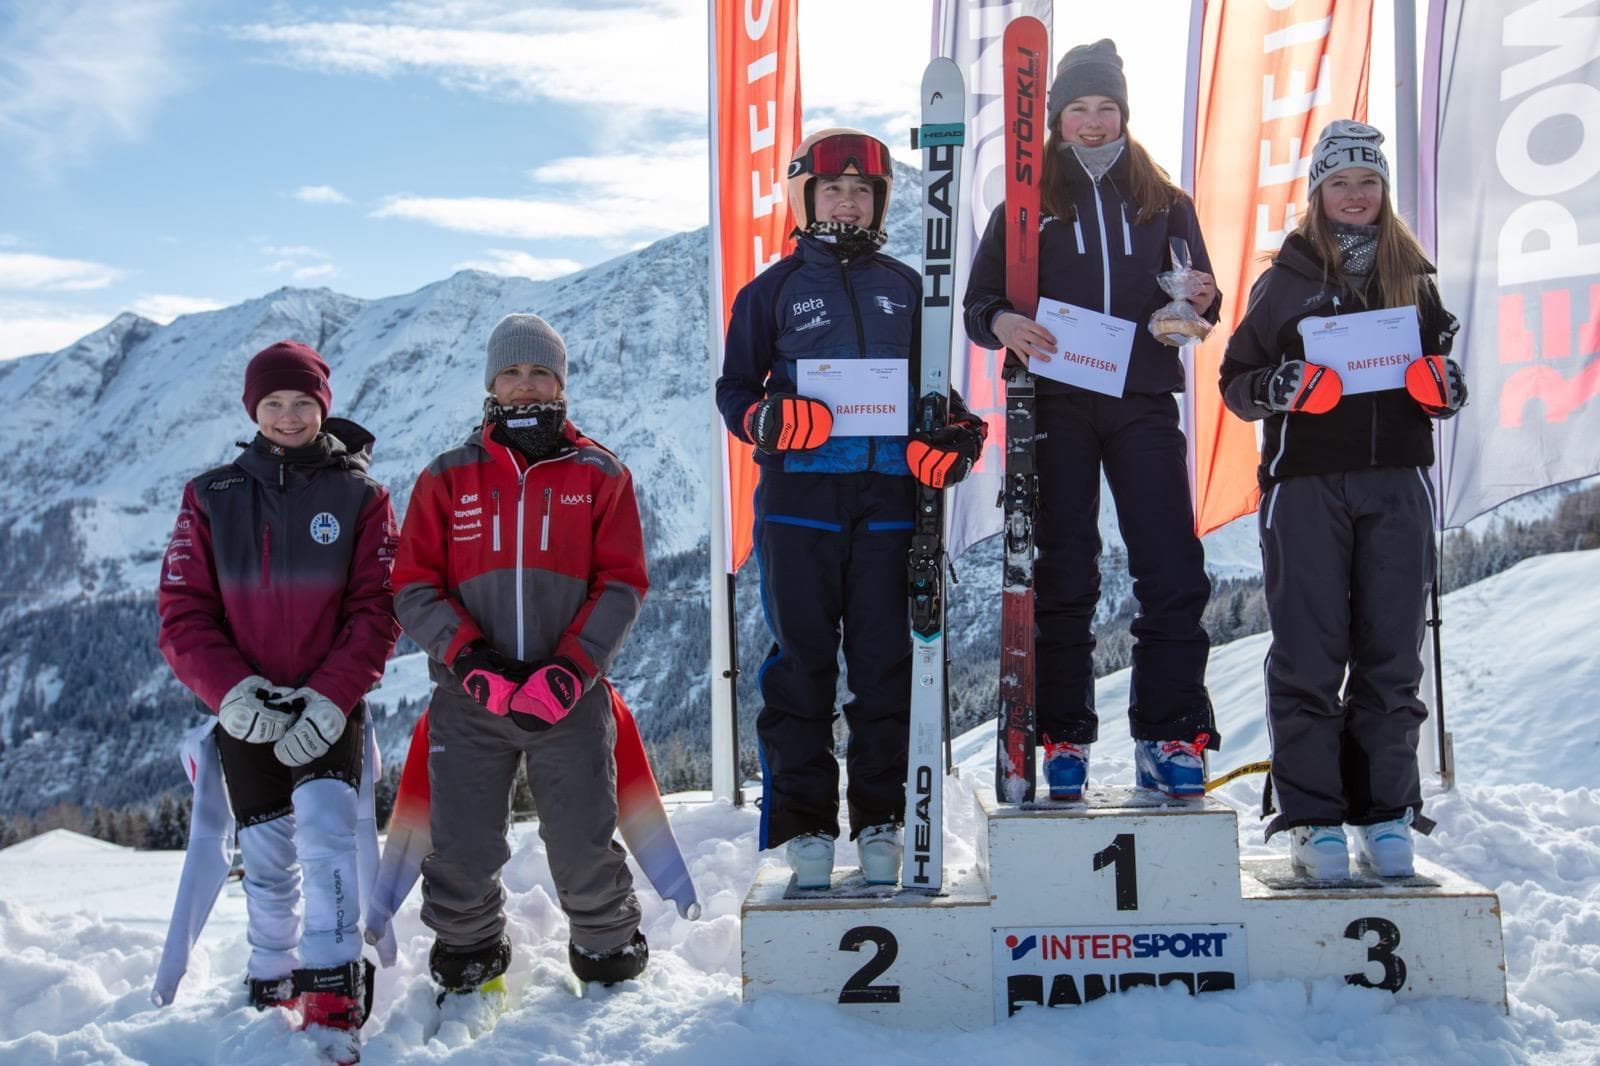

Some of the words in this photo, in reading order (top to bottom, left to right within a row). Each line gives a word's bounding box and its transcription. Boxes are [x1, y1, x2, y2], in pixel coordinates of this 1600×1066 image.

[1016, 46, 1033, 187] STÖCKLI
[924, 131, 963, 140] HEAD
[792, 297, 825, 316] Beta
[1063, 351, 1118, 373] RAIFFEISEN
[1347, 353, 1412, 372] RAIFFEISEN
[836, 404, 897, 415] RAIFFEISEN
[560, 494, 585, 504] LAAX
[914, 765, 932, 884] HEAD
[1093, 833, 1138, 911] 1
[1041, 932, 1228, 960] INTERSPORT
[1344, 917, 1407, 993] 3
[838, 926, 899, 1004] 2
